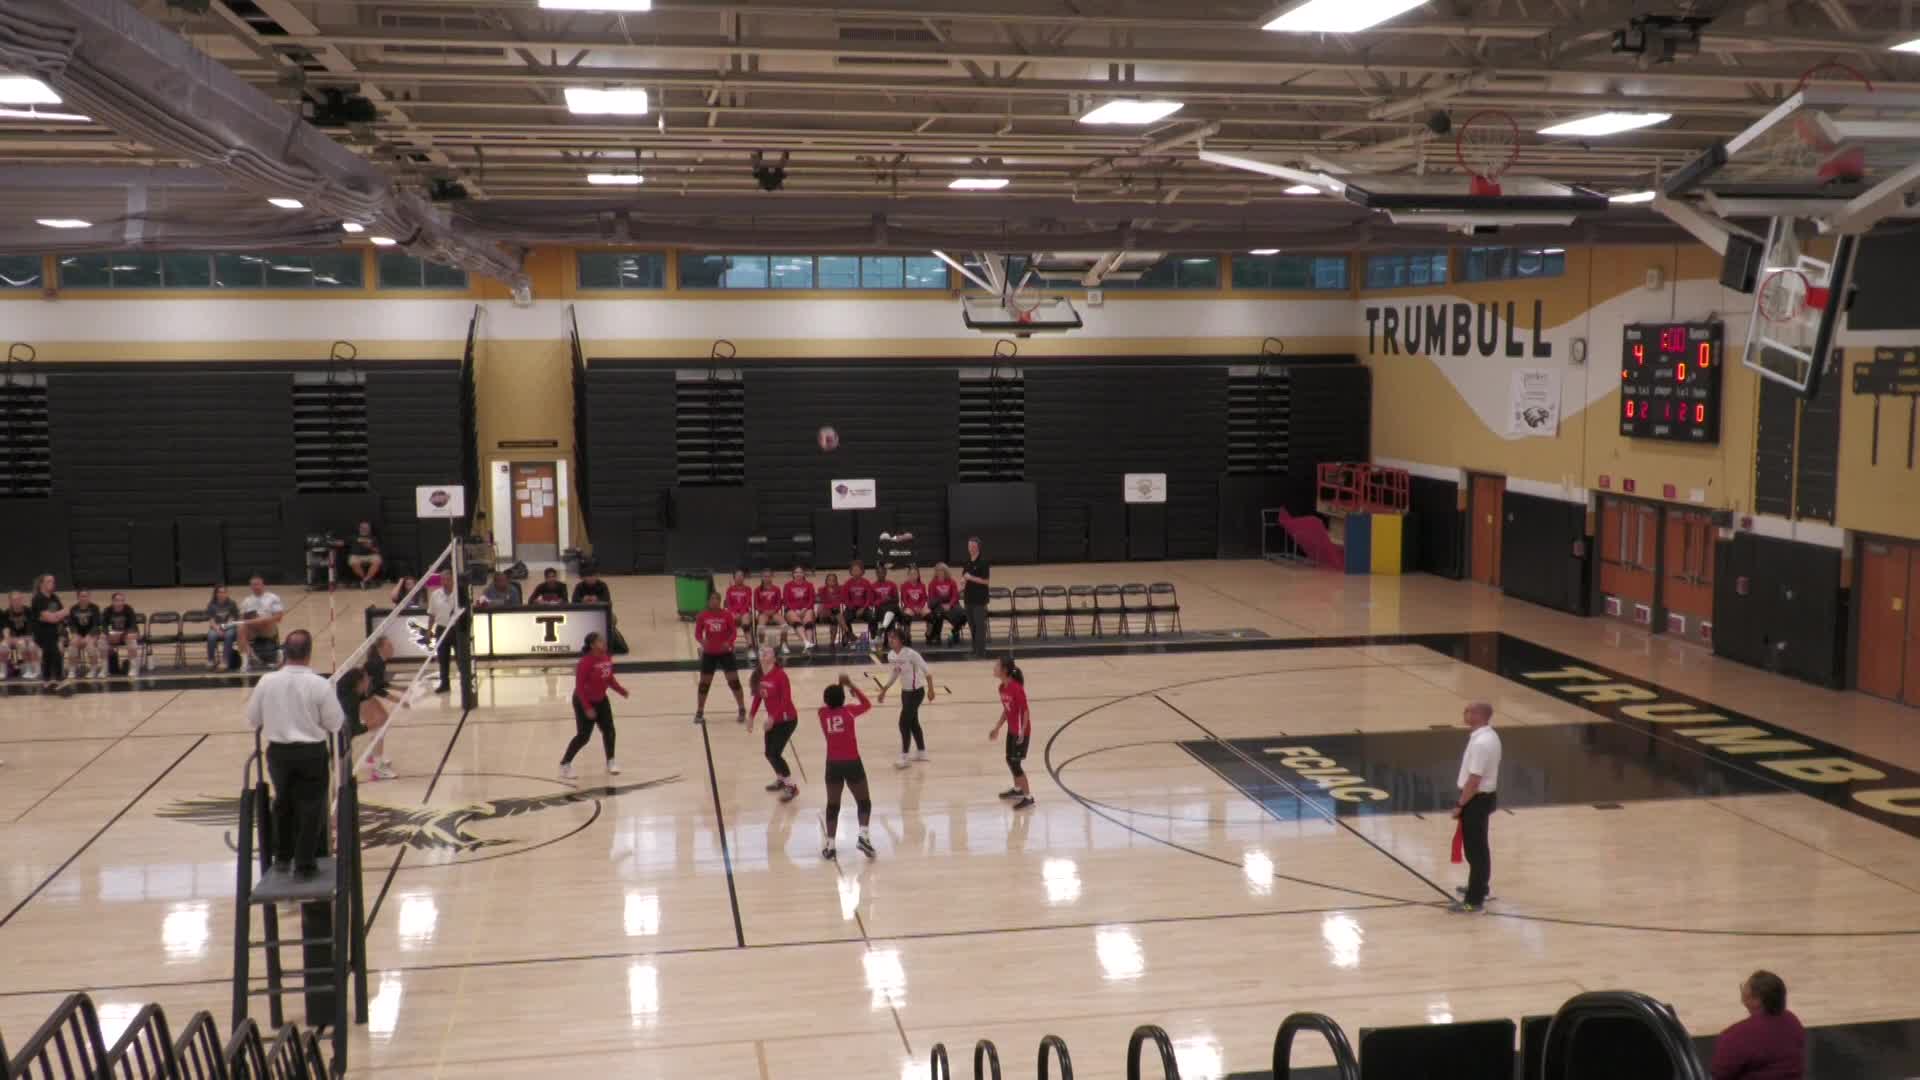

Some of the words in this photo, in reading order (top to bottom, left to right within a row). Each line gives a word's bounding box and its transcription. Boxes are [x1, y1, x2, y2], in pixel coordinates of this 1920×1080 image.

[1366, 299, 1552, 358] TRUMBULL
[1633, 344, 1644, 366] 4
[1699, 342, 1710, 368] 0
[1677, 362, 1686, 381] 0
[1626, 400, 1635, 418] 0
[1695, 404, 1705, 423] 0
[535, 615, 565, 642] T
[531, 645, 571, 653] ATHLETICS
[826, 715, 845, 733] 12
[1263, 746, 1390, 802] FCIAC
